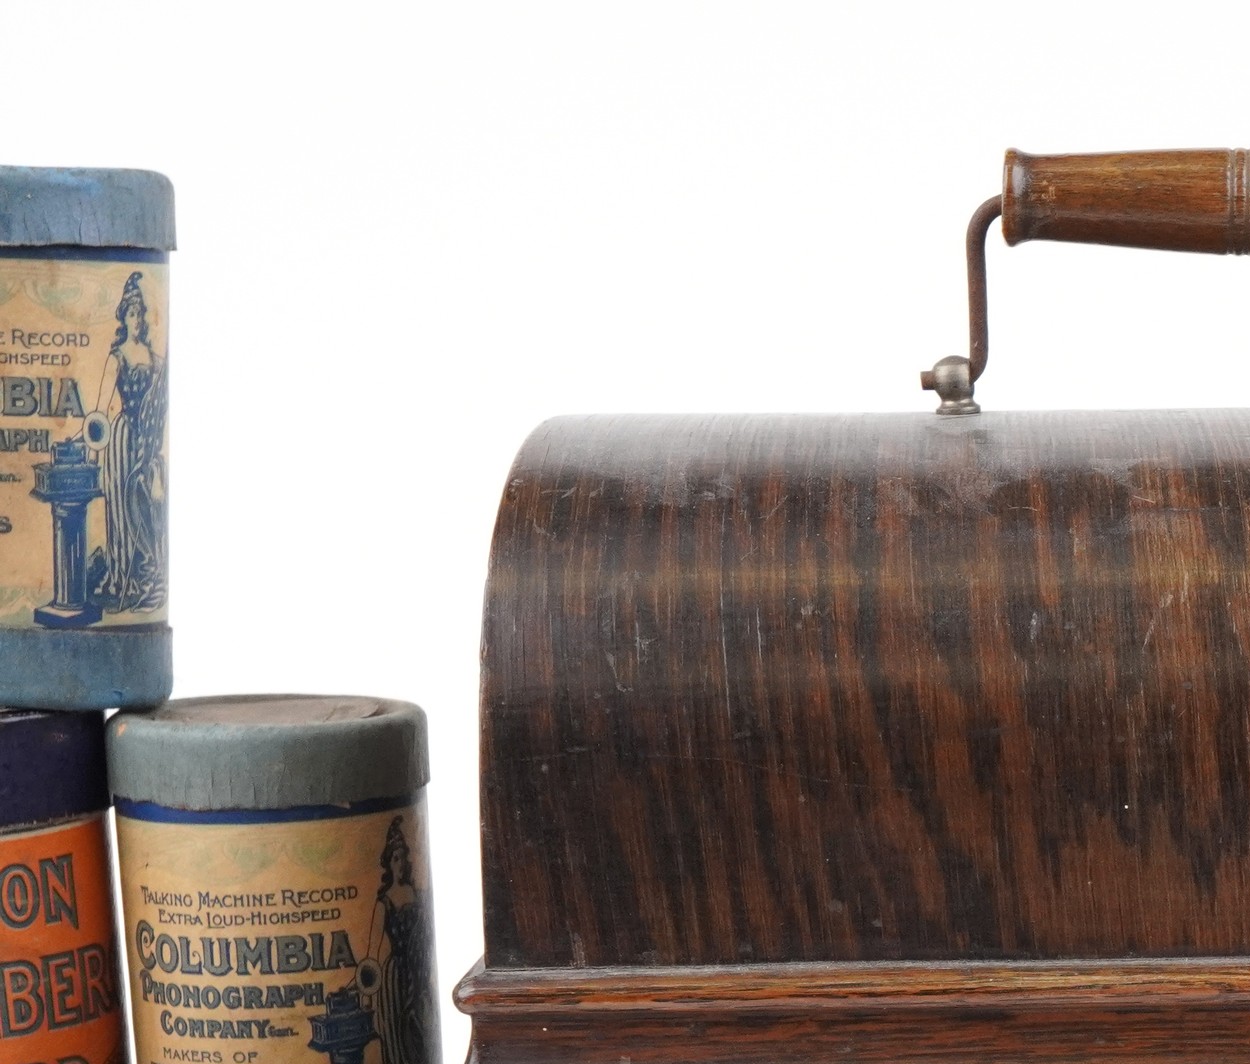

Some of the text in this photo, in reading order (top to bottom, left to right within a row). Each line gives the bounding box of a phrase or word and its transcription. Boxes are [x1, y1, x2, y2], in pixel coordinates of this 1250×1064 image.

[12, 328, 90, 350] RECORD
[140, 885, 358, 912] TALKING MACHINE RECORD
[158, 908, 203, 926] EXTRA
[136, 919, 358, 977] COLUMBIA
[139, 968, 327, 1011] PHONOGRAPH
[160, 1009, 270, 1039] COMPANY
[163, 1047, 259, 1064] MAKERS OF
